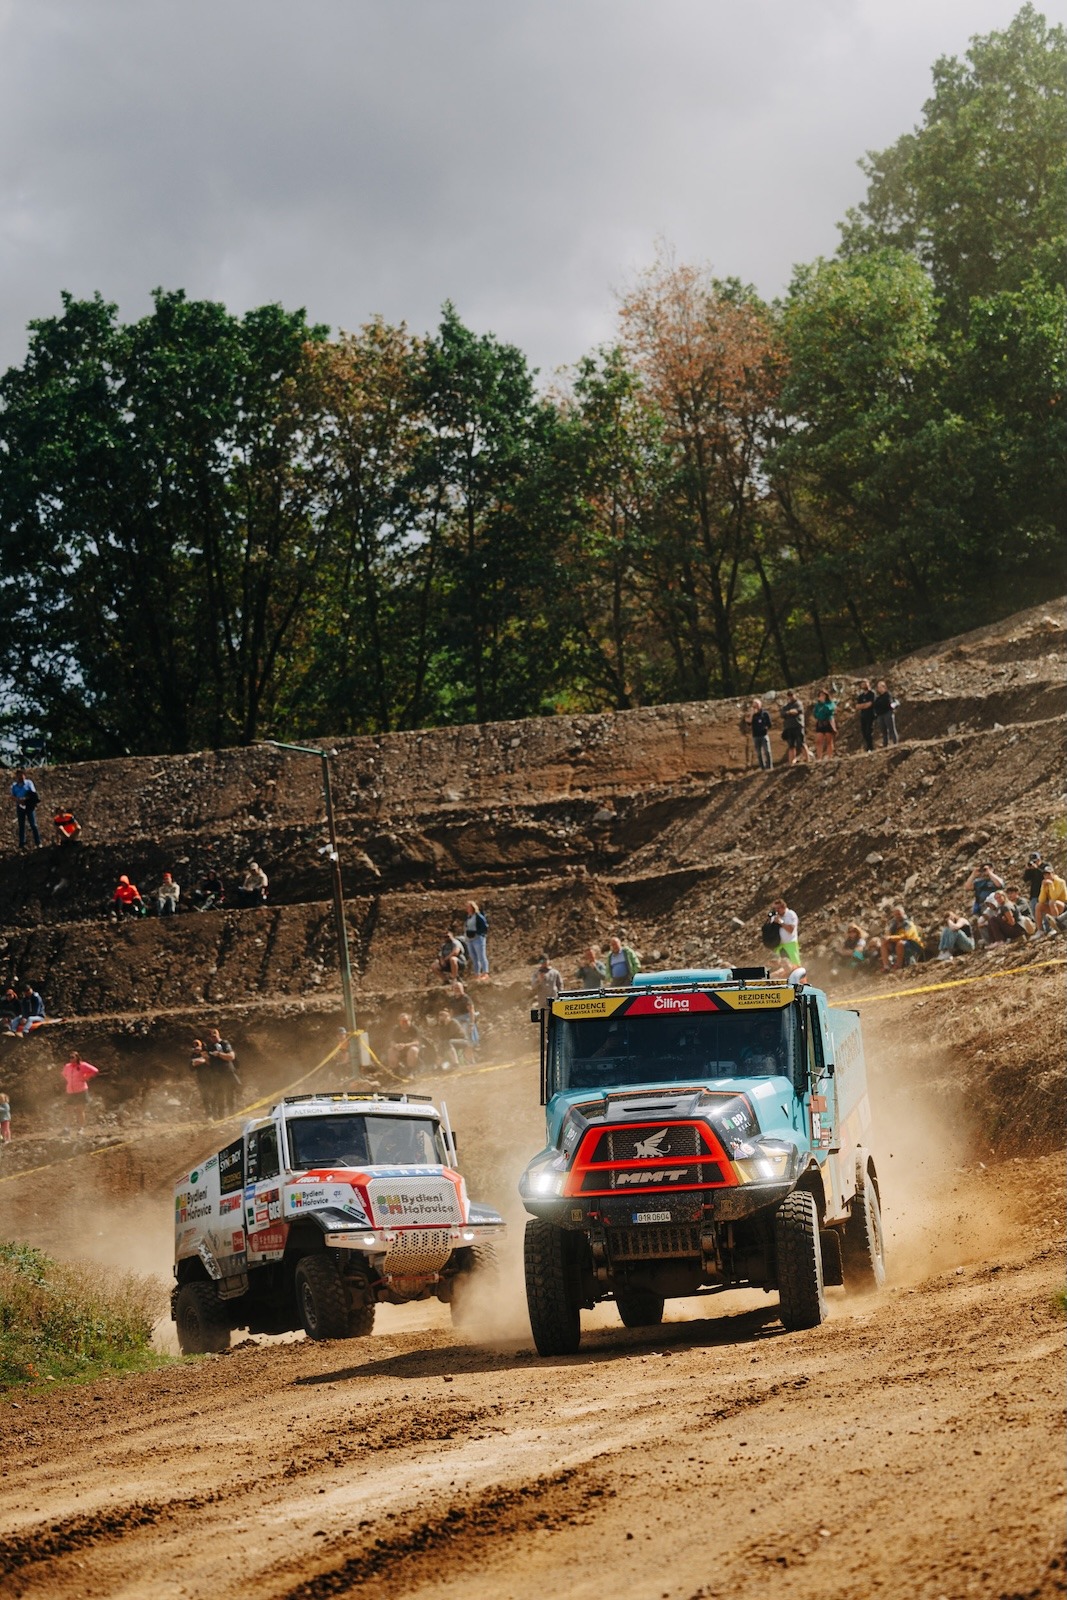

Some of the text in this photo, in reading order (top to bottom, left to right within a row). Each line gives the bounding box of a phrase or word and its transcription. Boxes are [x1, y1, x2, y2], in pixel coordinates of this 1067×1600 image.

[653, 995, 690, 1009] Čilina
[738, 992, 781, 1001] REZIDENCE
[564, 1002, 606, 1011] REZIDENCE
[731, 1111, 748, 1127] BPJ
[220, 1150, 242, 1172] SYNERGY
[616, 1170, 688, 1185] MMT
[187, 1186, 208, 1207] Bydlení
[302, 1189, 325, 1200] Bydlení
[401, 1194, 443, 1205] Bydlení
[302, 1198, 329, 1207] Hořovice
[403, 1203, 454, 1214] Hořovice
